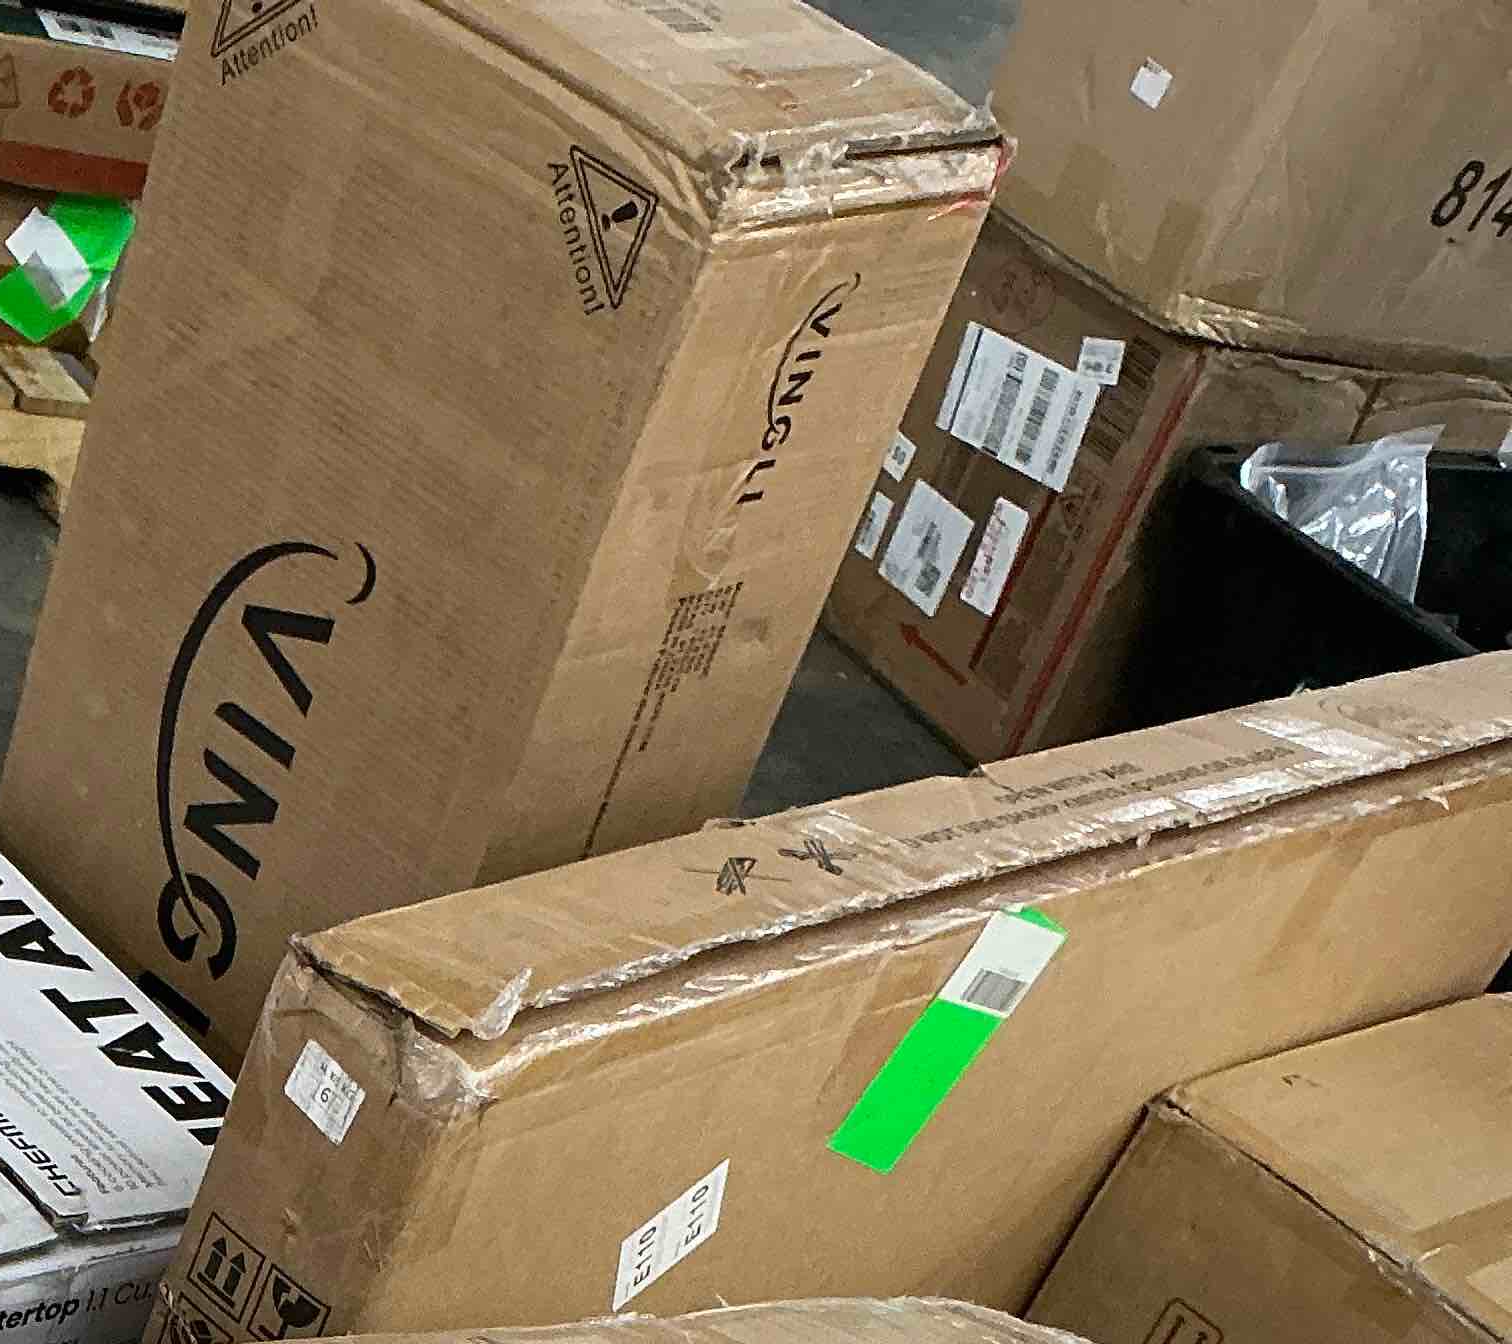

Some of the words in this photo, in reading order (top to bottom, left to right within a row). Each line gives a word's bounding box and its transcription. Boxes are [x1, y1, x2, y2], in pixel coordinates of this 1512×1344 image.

[220, 14, 320, 86] Attention!
[547, 161, 606, 316] Attention!
[737, 303, 843, 504] VINGLI
[684, 1184, 710, 1246] E110
[633, 1226, 657, 1287] E110
